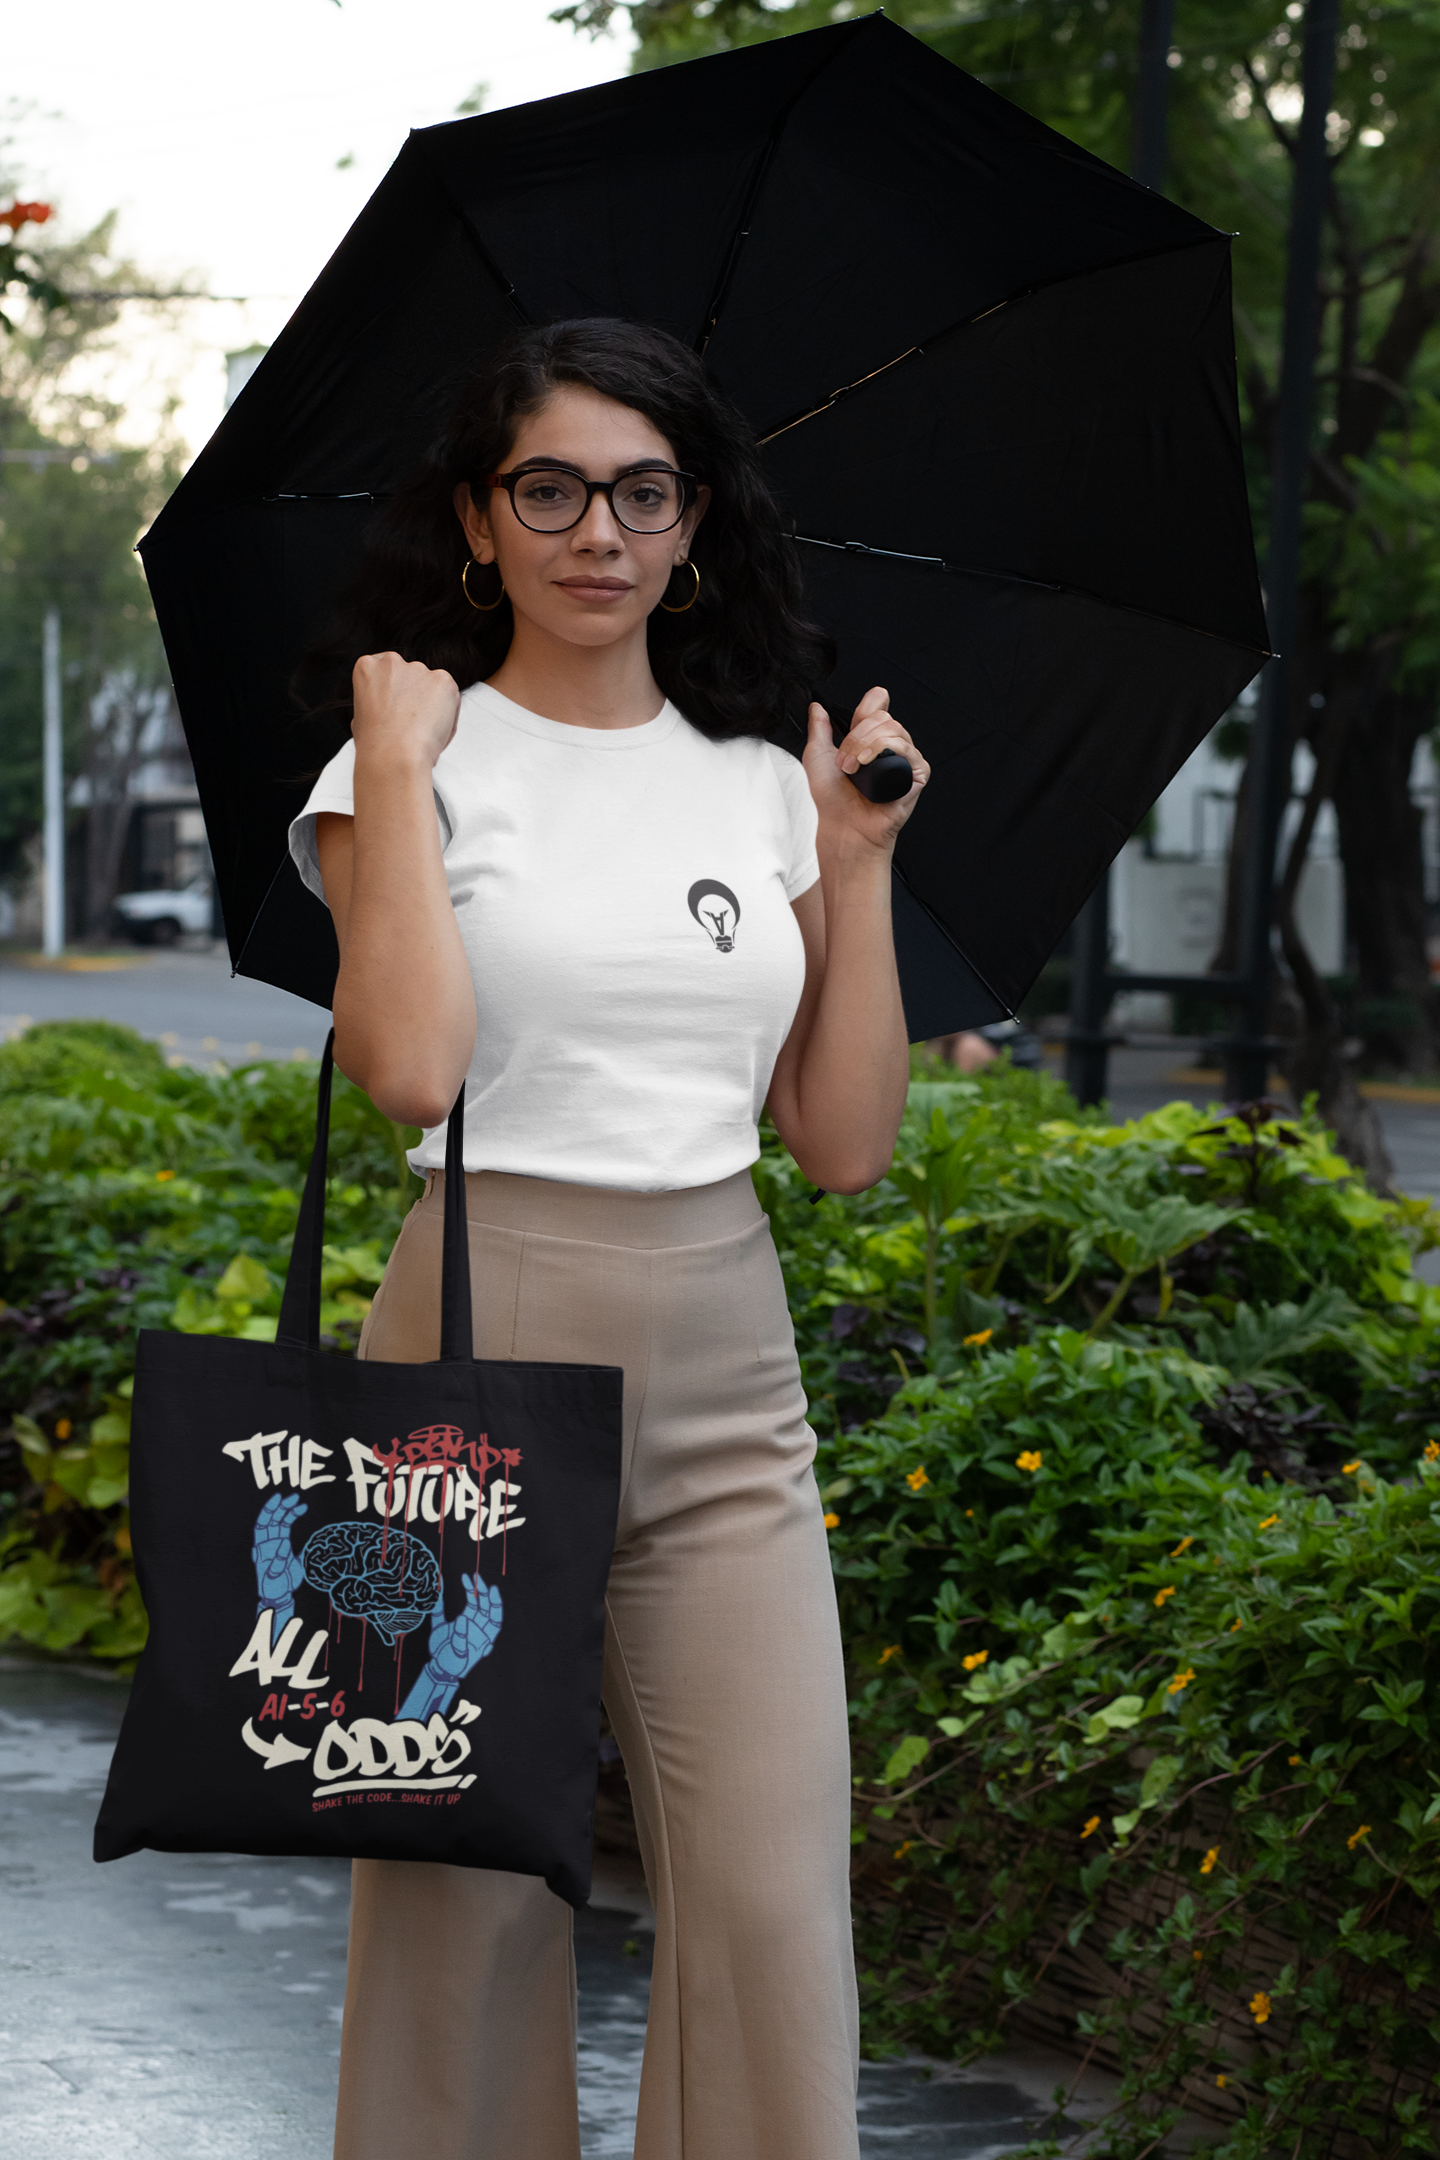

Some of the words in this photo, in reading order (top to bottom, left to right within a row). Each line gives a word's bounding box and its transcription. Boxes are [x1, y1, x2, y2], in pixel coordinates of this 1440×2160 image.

[222, 1430, 336, 1489] THE
[342, 1437, 526, 1541] FUTURE
[229, 1609, 330, 1689] ALL
[312, 1797, 343, 1812] SHAKE
[346, 1795, 364, 1804] THE
[433, 1795, 445, 1805] IT
[446, 1793, 461, 1805] UP
